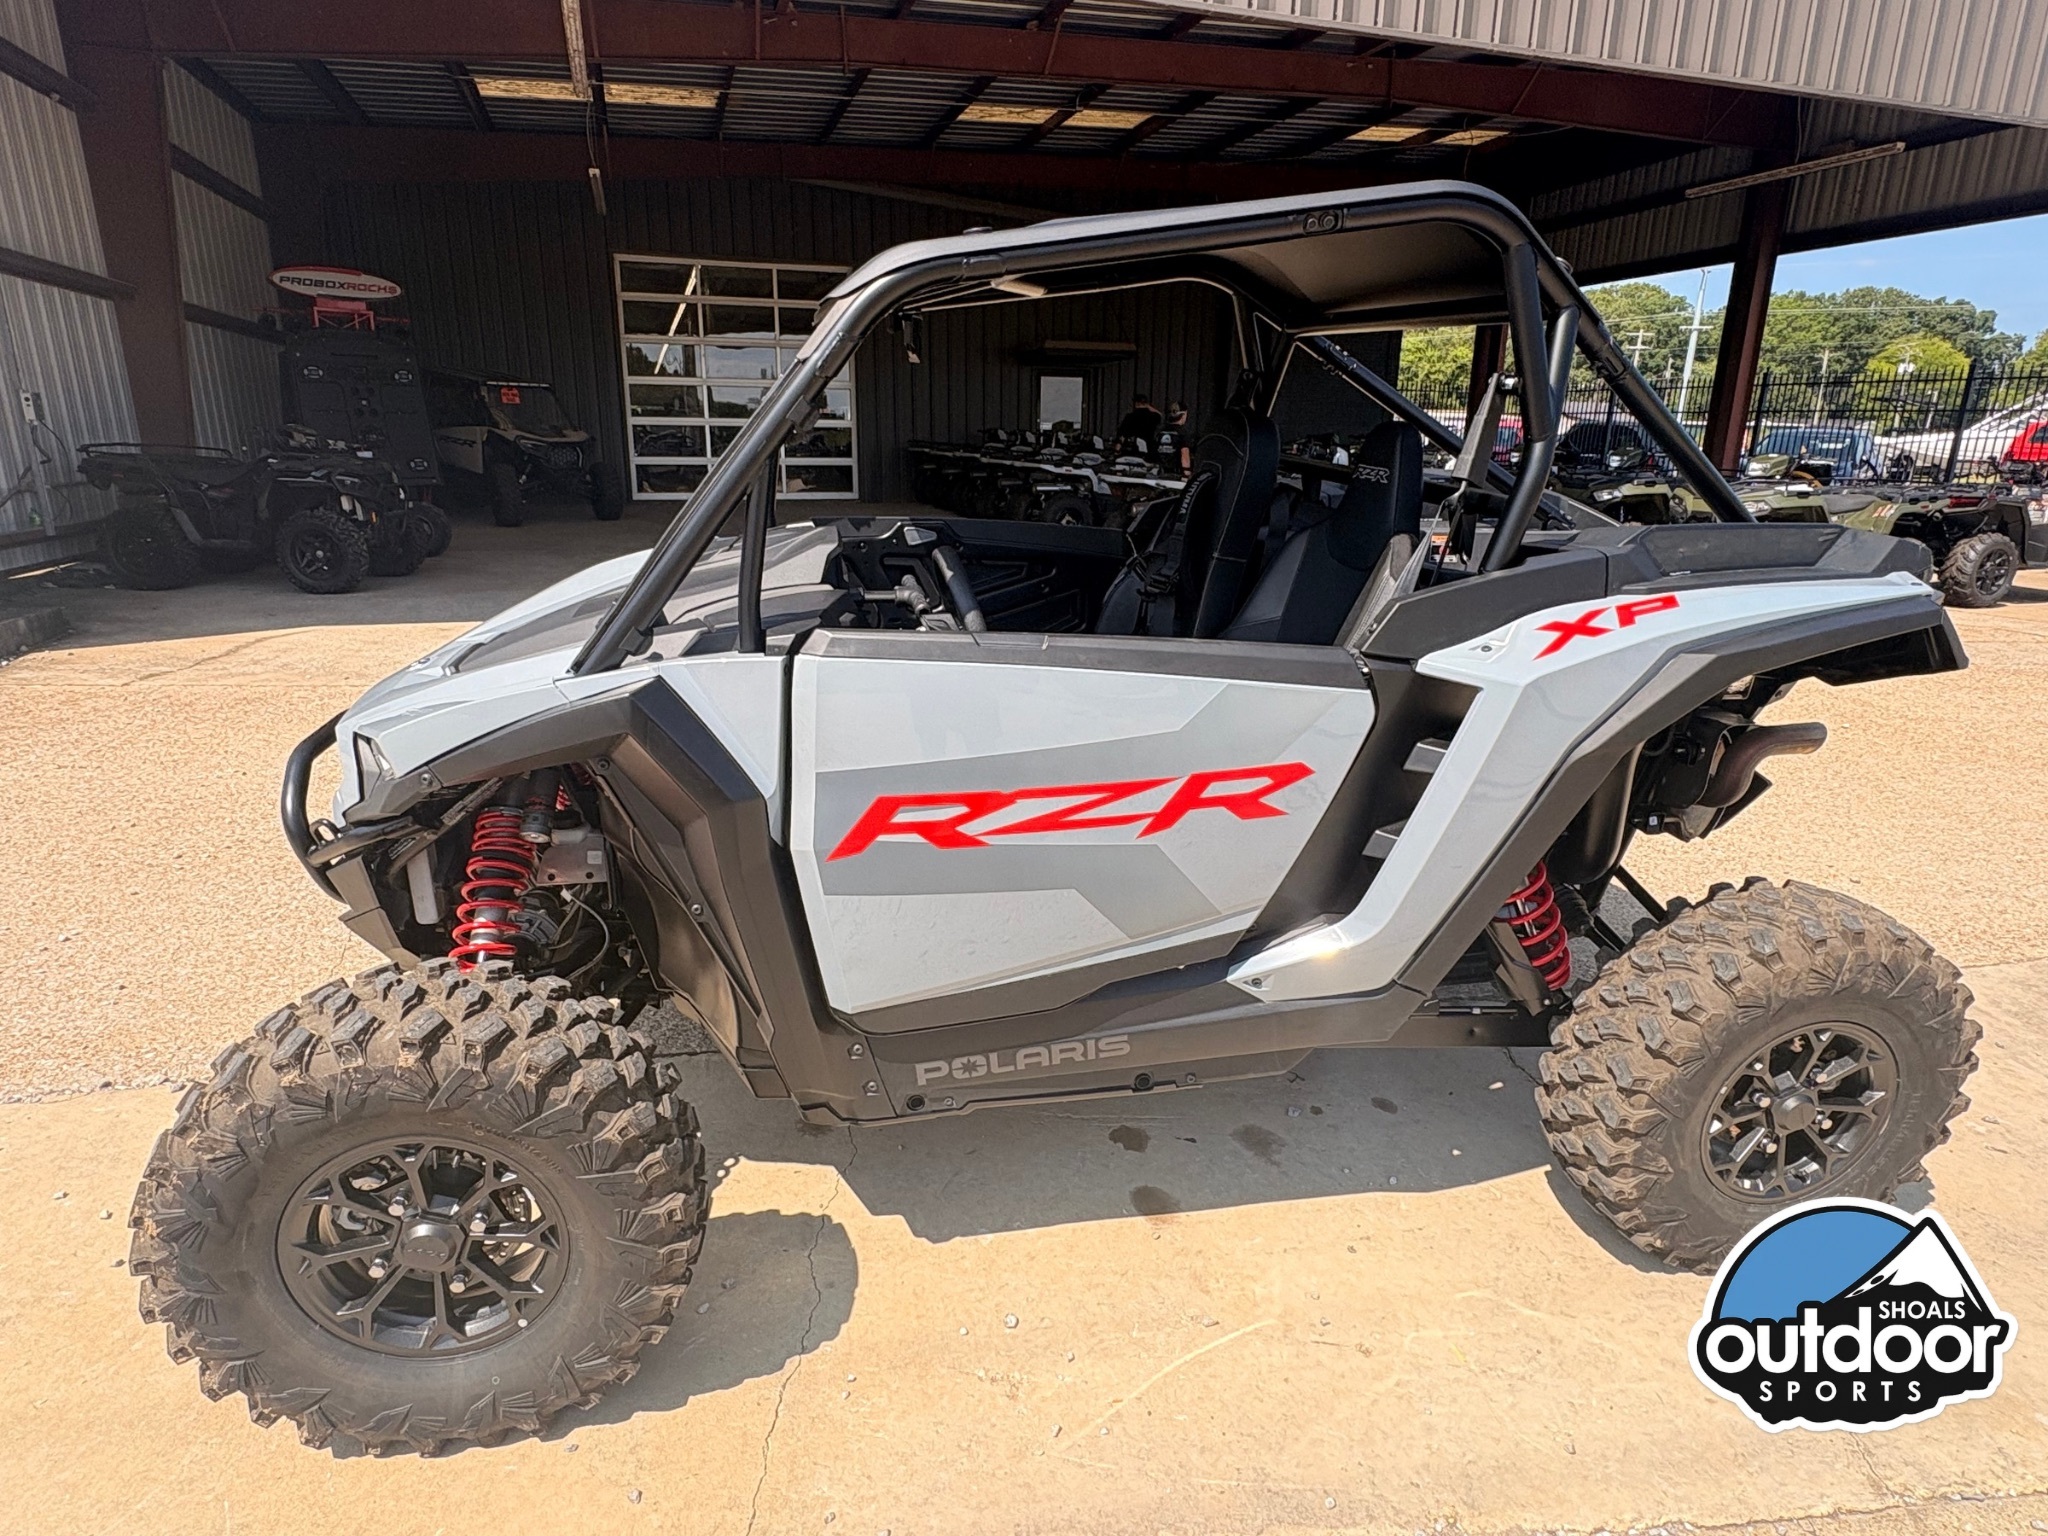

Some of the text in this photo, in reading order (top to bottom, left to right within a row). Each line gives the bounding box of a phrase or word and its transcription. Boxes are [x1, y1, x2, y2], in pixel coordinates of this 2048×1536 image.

[279, 275, 398, 295] PROBOXROCKS
[1532, 594, 1680, 661] XP
[826, 761, 1316, 863] RZR
[914, 1034, 1131, 1086] POLARIS
